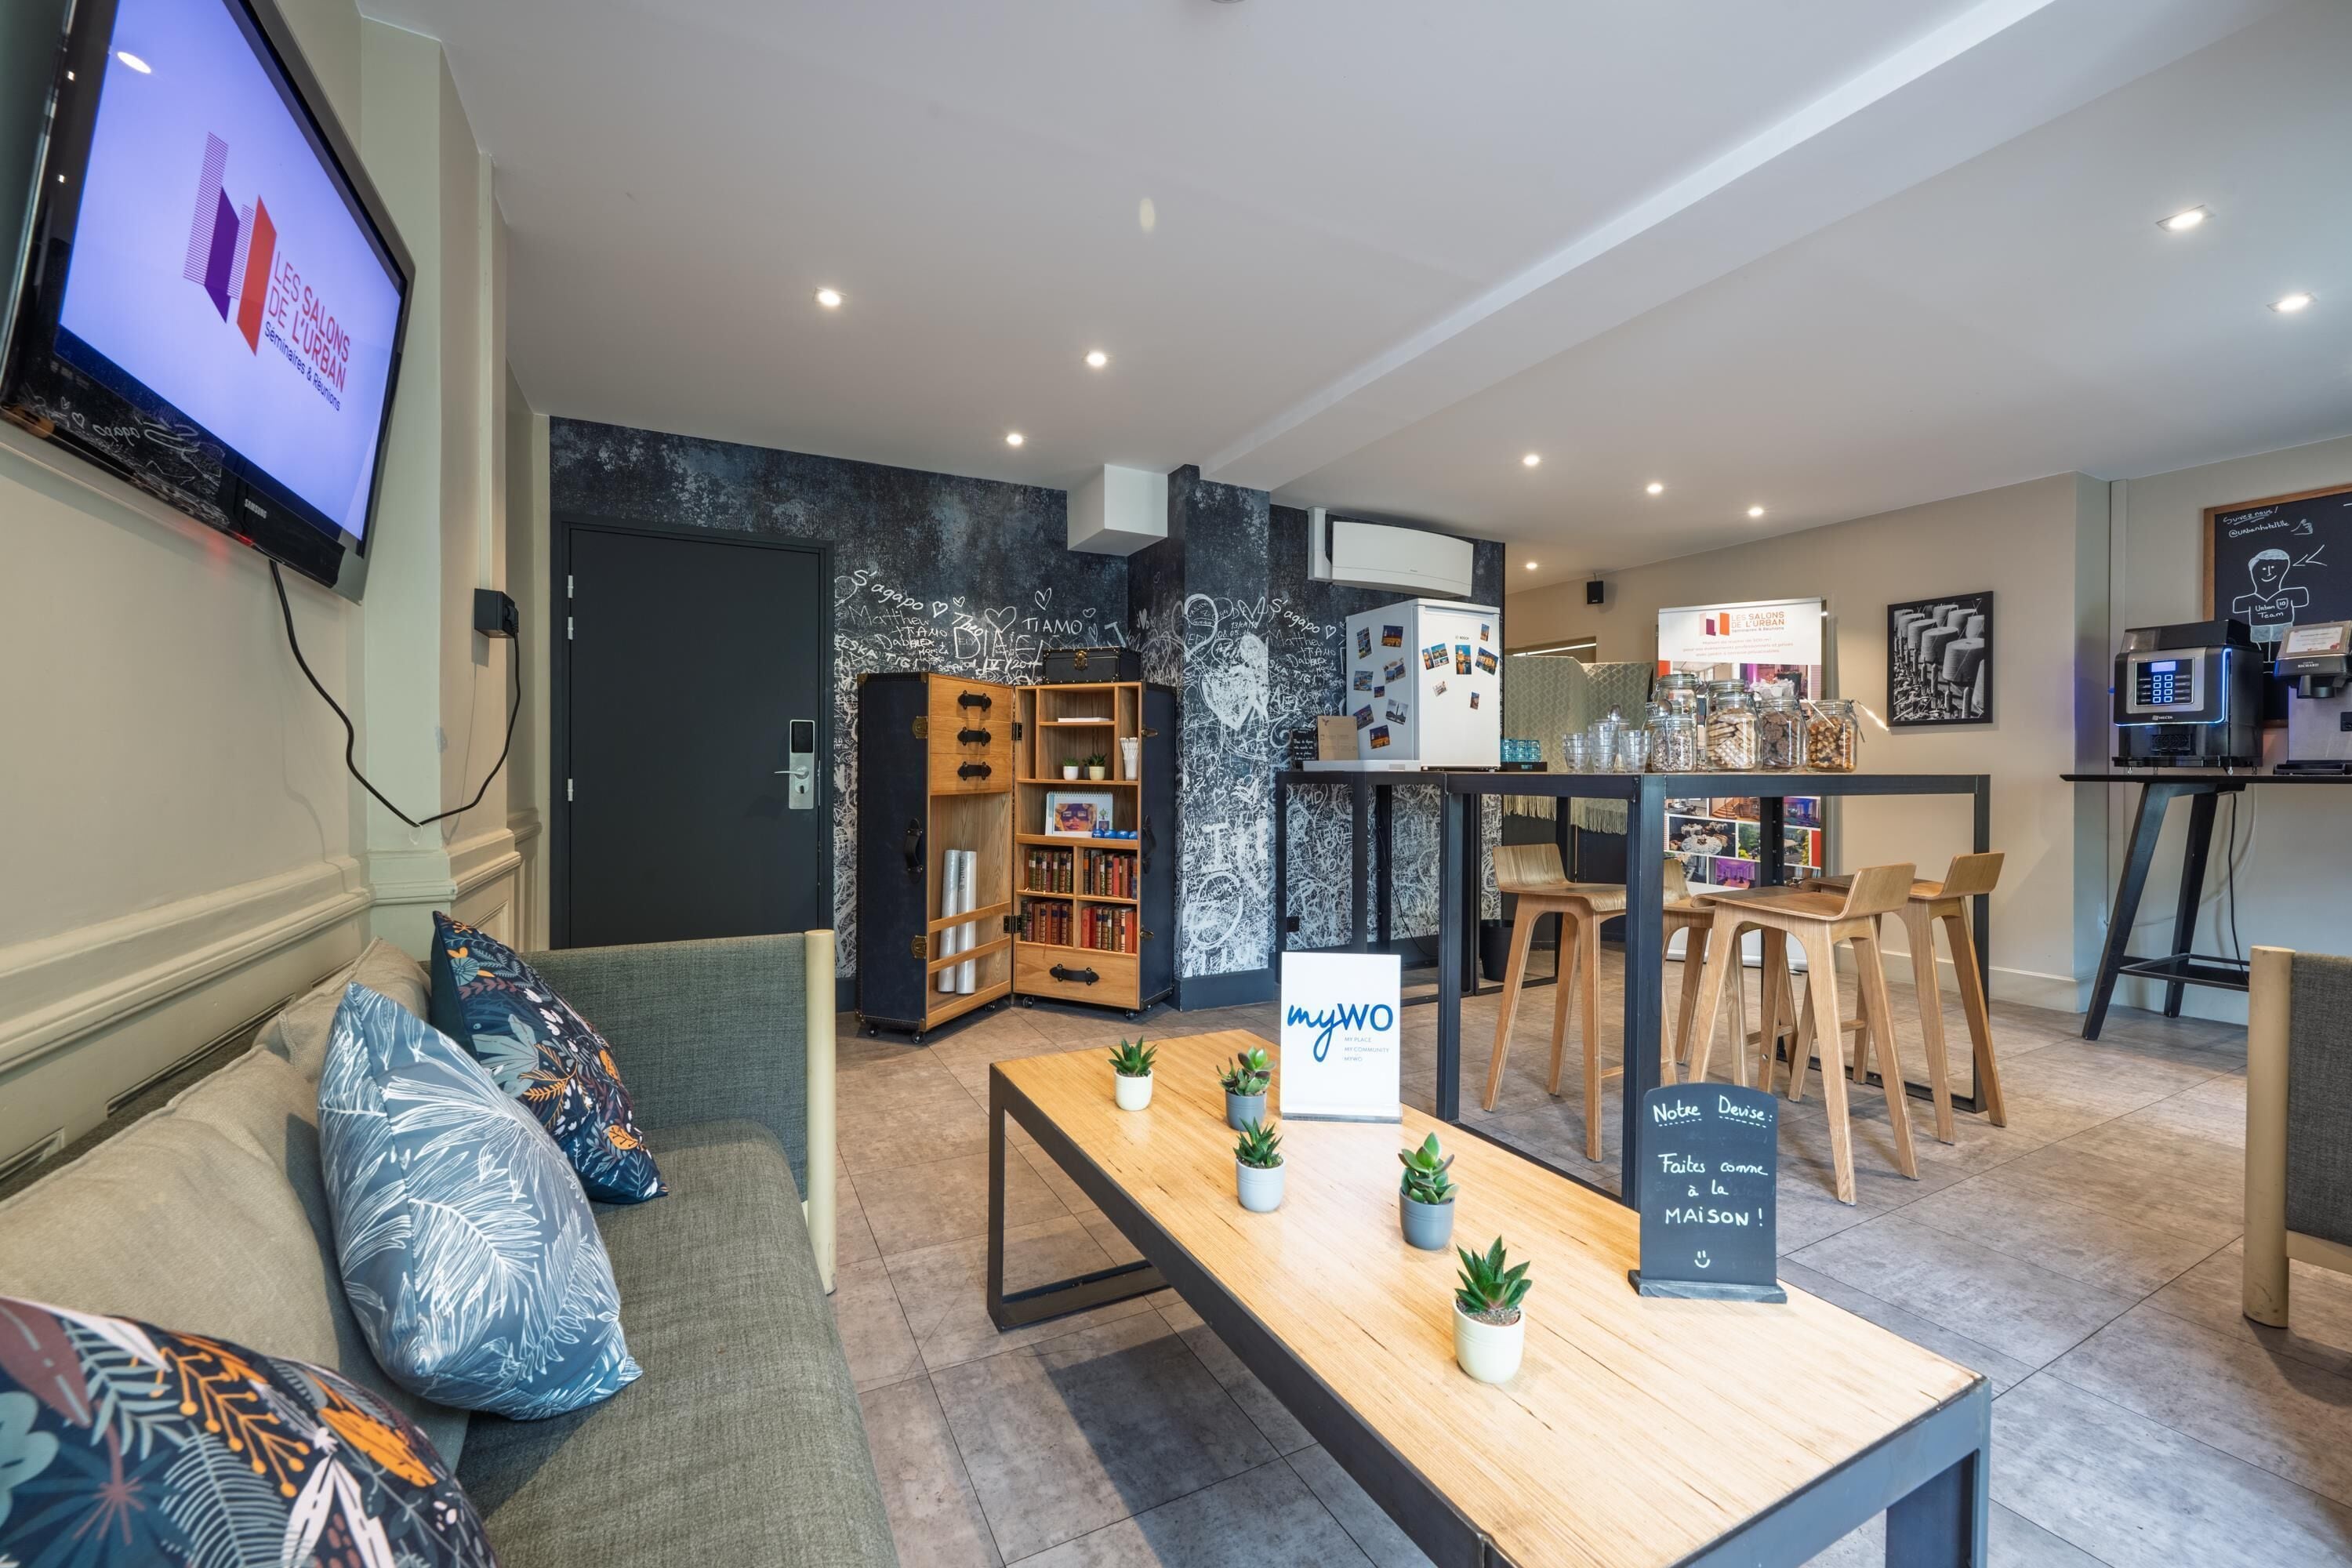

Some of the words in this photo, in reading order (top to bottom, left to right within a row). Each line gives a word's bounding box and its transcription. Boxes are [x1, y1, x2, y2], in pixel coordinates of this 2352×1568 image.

[274, 251, 300, 302] LES
[302, 285, 350, 362] SALONS
[268, 285, 289, 329] DE
[292, 310, 346, 393] L'URBAN
[264, 321, 306, 375] Séminaires
[307, 366, 312, 381] &
[313, 372, 340, 412] Réunions
[245, 497, 267, 520] SAMSUNG
[2223, 514, 2252, 524] Suivez
[1746, 619, 1784, 628] L'URBAN
[1748, 612, 1784, 620] SALONS
[2257, 611, 2284, 619] Team
[1653, 1099, 1700, 1123] Notre
[1657, 1152, 1706, 1174] Faites
[1687, 1185, 1700, 1198] à
[1711, 1179, 1730, 1196] la
